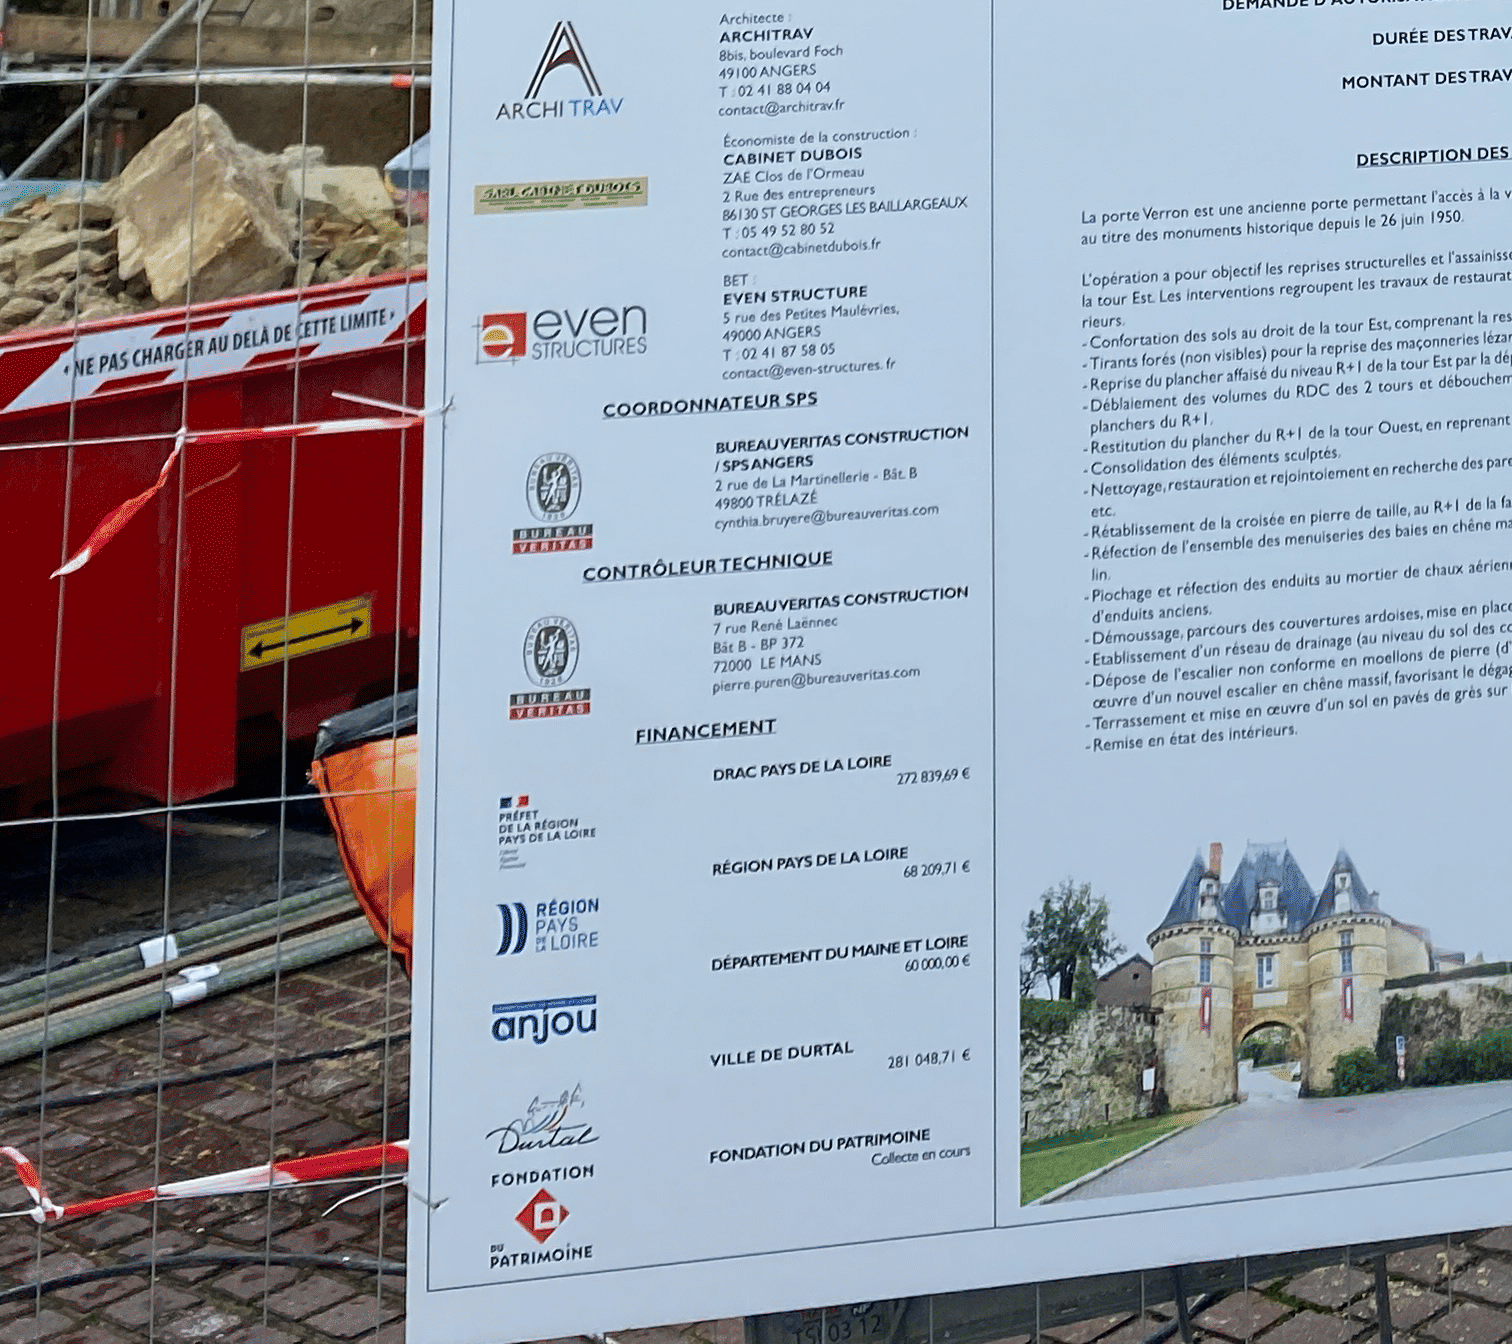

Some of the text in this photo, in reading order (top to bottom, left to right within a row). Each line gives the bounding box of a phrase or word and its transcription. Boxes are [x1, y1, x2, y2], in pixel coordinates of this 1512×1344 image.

[719, 27, 814, 44] ARCHITRAV
[1372, 27, 1429, 46] DURÉE
[1433, 28, 1466, 43] DES
[1342, 72, 1431, 90] MONTANT
[1435, 70, 1467, 85] DES
[723, 146, 863, 166] CABINET DUBOIS
[1356, 147, 1473, 168] DESCRIPTION
[1475, 145, 1509, 162] DES
[1080, 209, 1465, 246] au titre des monuments historique depuis le 26 juin 1950.
[723, 285, 868, 306] EVEN STRUCTURE
[532, 305, 647, 341] even
[75, 356, 94, 376] NE
[99, 351, 128, 374] PAS
[132, 339, 204, 368] CHARGER
[208, 335, 229, 355] AU
[274, 324, 291, 344] DE
[297, 316, 336, 340] CETTE
[340, 308, 386, 332] LIMITE
[531, 335, 648, 361] STRUCTURES
[602, 391, 818, 418] COORDONNATEUR SPS
[715, 425, 969, 455] BUREAU VERITAS CONSTRUCTION
[519, 526, 587, 540] BUREAU
[519, 540, 588, 553] VERITAS
[582, 550, 833, 582] CONTRÔLEUR TECHNIQUE
[636, 718, 777, 744] FINANCEMENT
[713, 754, 892, 782] DRAC PAYS DE LA LOIRE
[536, 897, 600, 918] RÉGION
[535, 915, 579, 936] PAYS
[550, 931, 599, 952] LOIRE
[492, 1006, 597, 1045] anjou
[709, 1127, 931, 1164] FONDATION DU PATRIMOINE
[491, 1163, 595, 1188] FONDATION
[489, 1242, 593, 1270] PATRIMOINE
